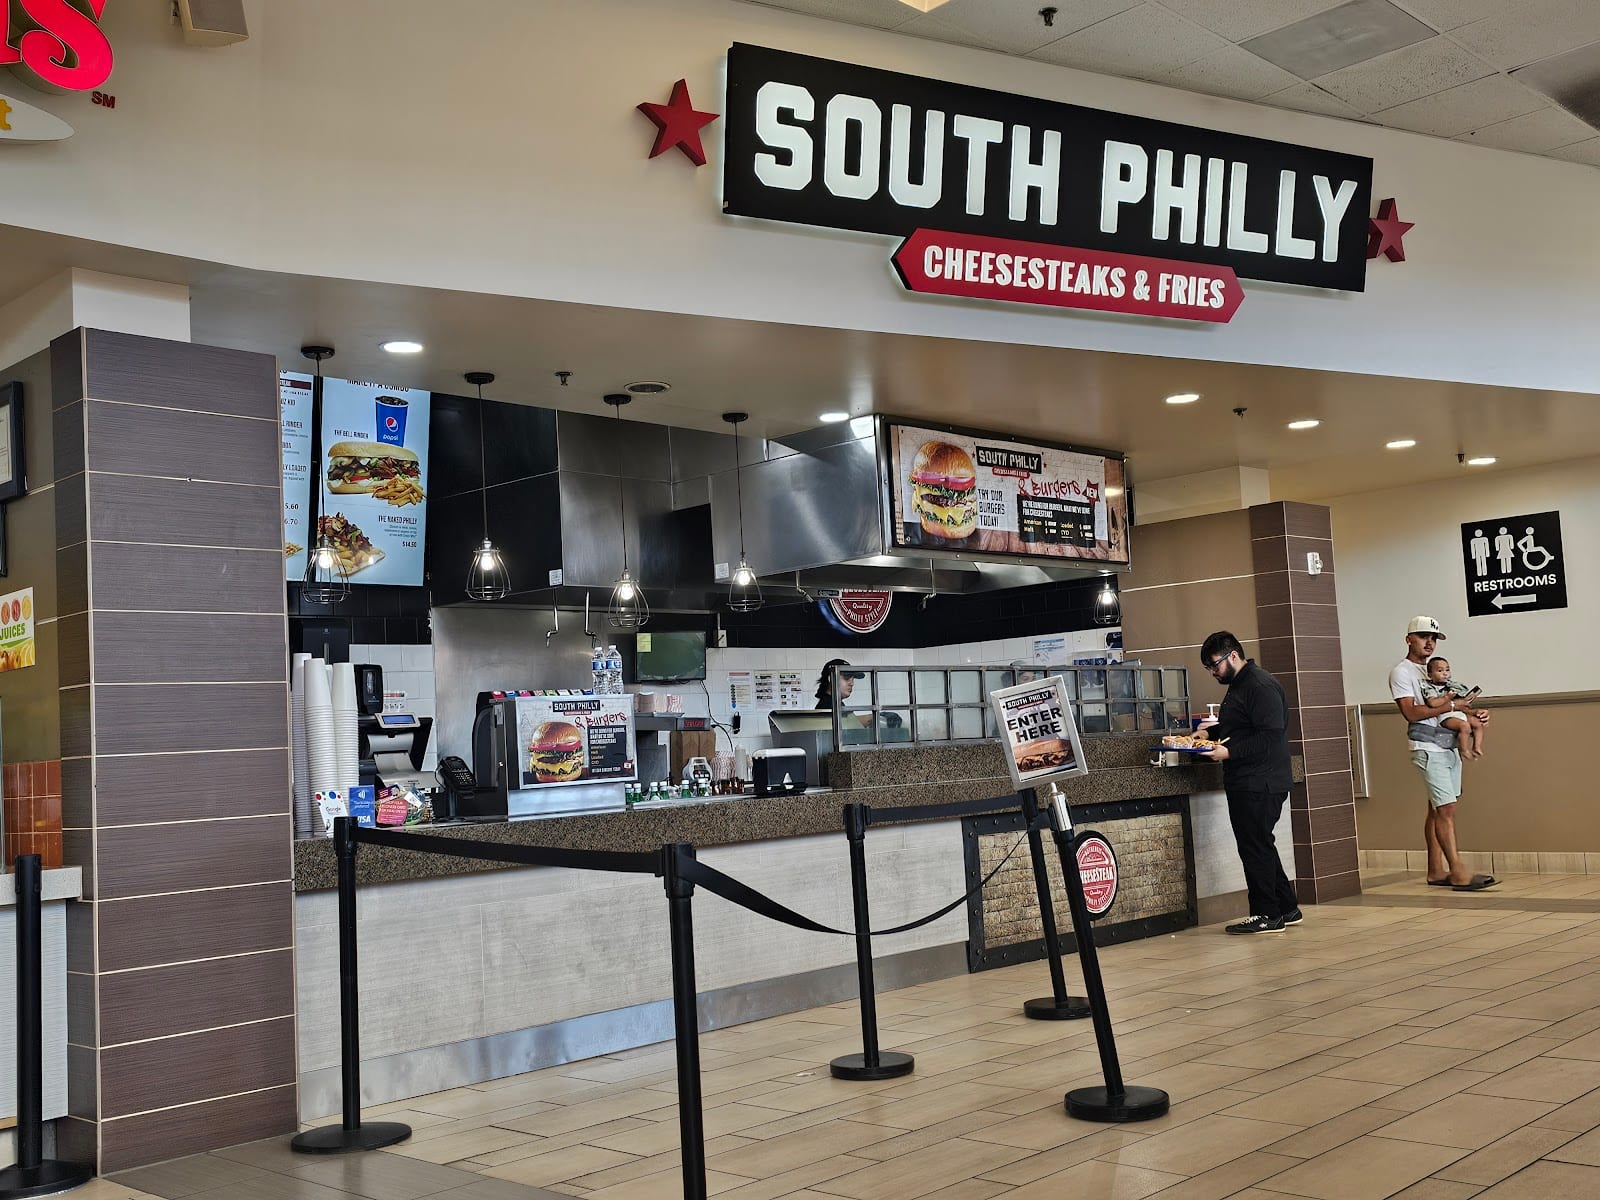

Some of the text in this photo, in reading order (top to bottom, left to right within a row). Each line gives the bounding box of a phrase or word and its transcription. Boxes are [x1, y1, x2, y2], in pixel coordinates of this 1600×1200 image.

[91, 91, 116, 109] SM
[754, 80, 1358, 263] SOUTH PHILLY
[922, 244, 1226, 309] CHEESESTEAKS & FRIES
[979, 450, 1038, 470] SOUTH PHILLY
[978, 489, 1003, 501] TRY OUR
[1031, 479, 1081, 501] Burgers
[979, 502, 1005, 514] BURGERS
[1473, 573, 1557, 593] RESTROOMS
[554, 701, 599, 711] SOUTH PHILLY
[1006, 690, 1050, 708] SOUTH PHILLY
[1007, 707, 1062, 731] ENTER
[1015, 721, 1062, 743] HERE
